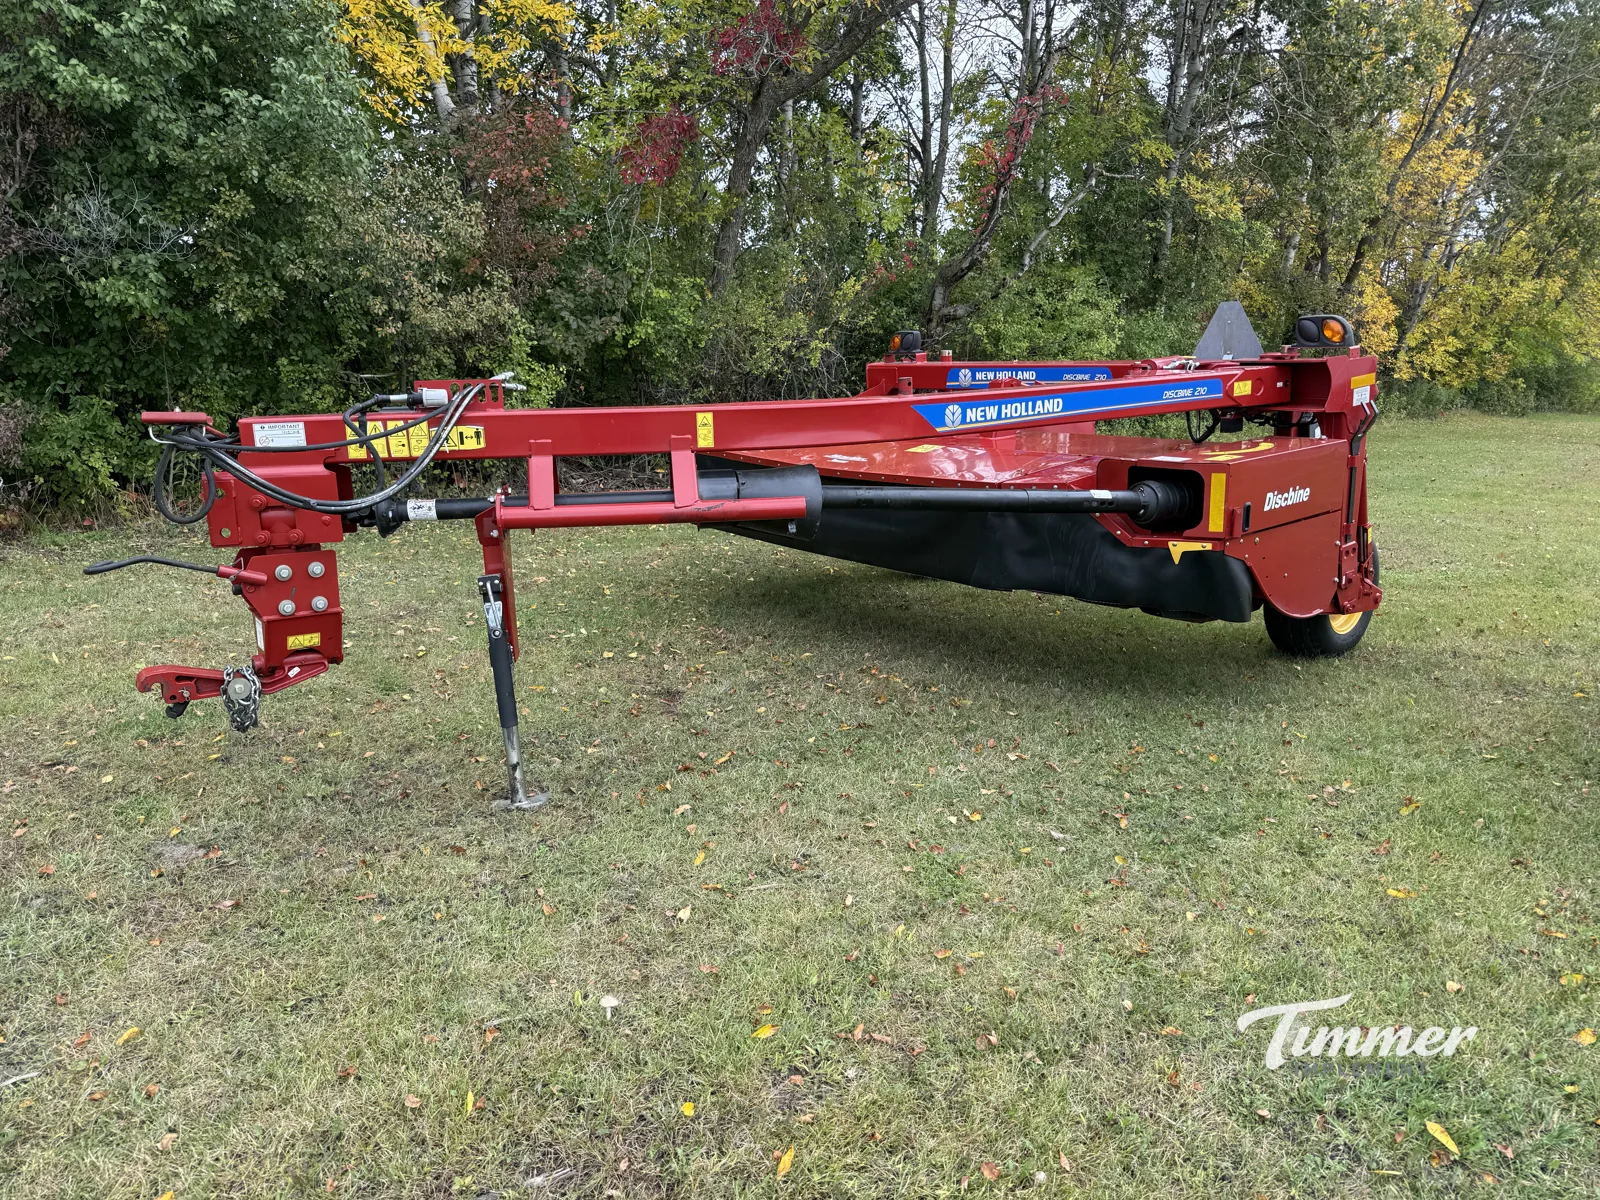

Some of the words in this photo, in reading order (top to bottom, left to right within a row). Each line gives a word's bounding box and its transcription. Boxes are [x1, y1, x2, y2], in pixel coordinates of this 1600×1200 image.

[975, 371, 994, 380] NEW
[1062, 373, 1091, 381] DISCBINE
[1094, 373, 1107, 381] 210
[1162, 388, 1193, 399] DISCBINE
[1194, 386, 1207, 396] 210
[966, 404, 998, 422] NEW
[1001, 398, 1063, 418] HOLLAND
[1264, 486, 1310, 511] Discbine
